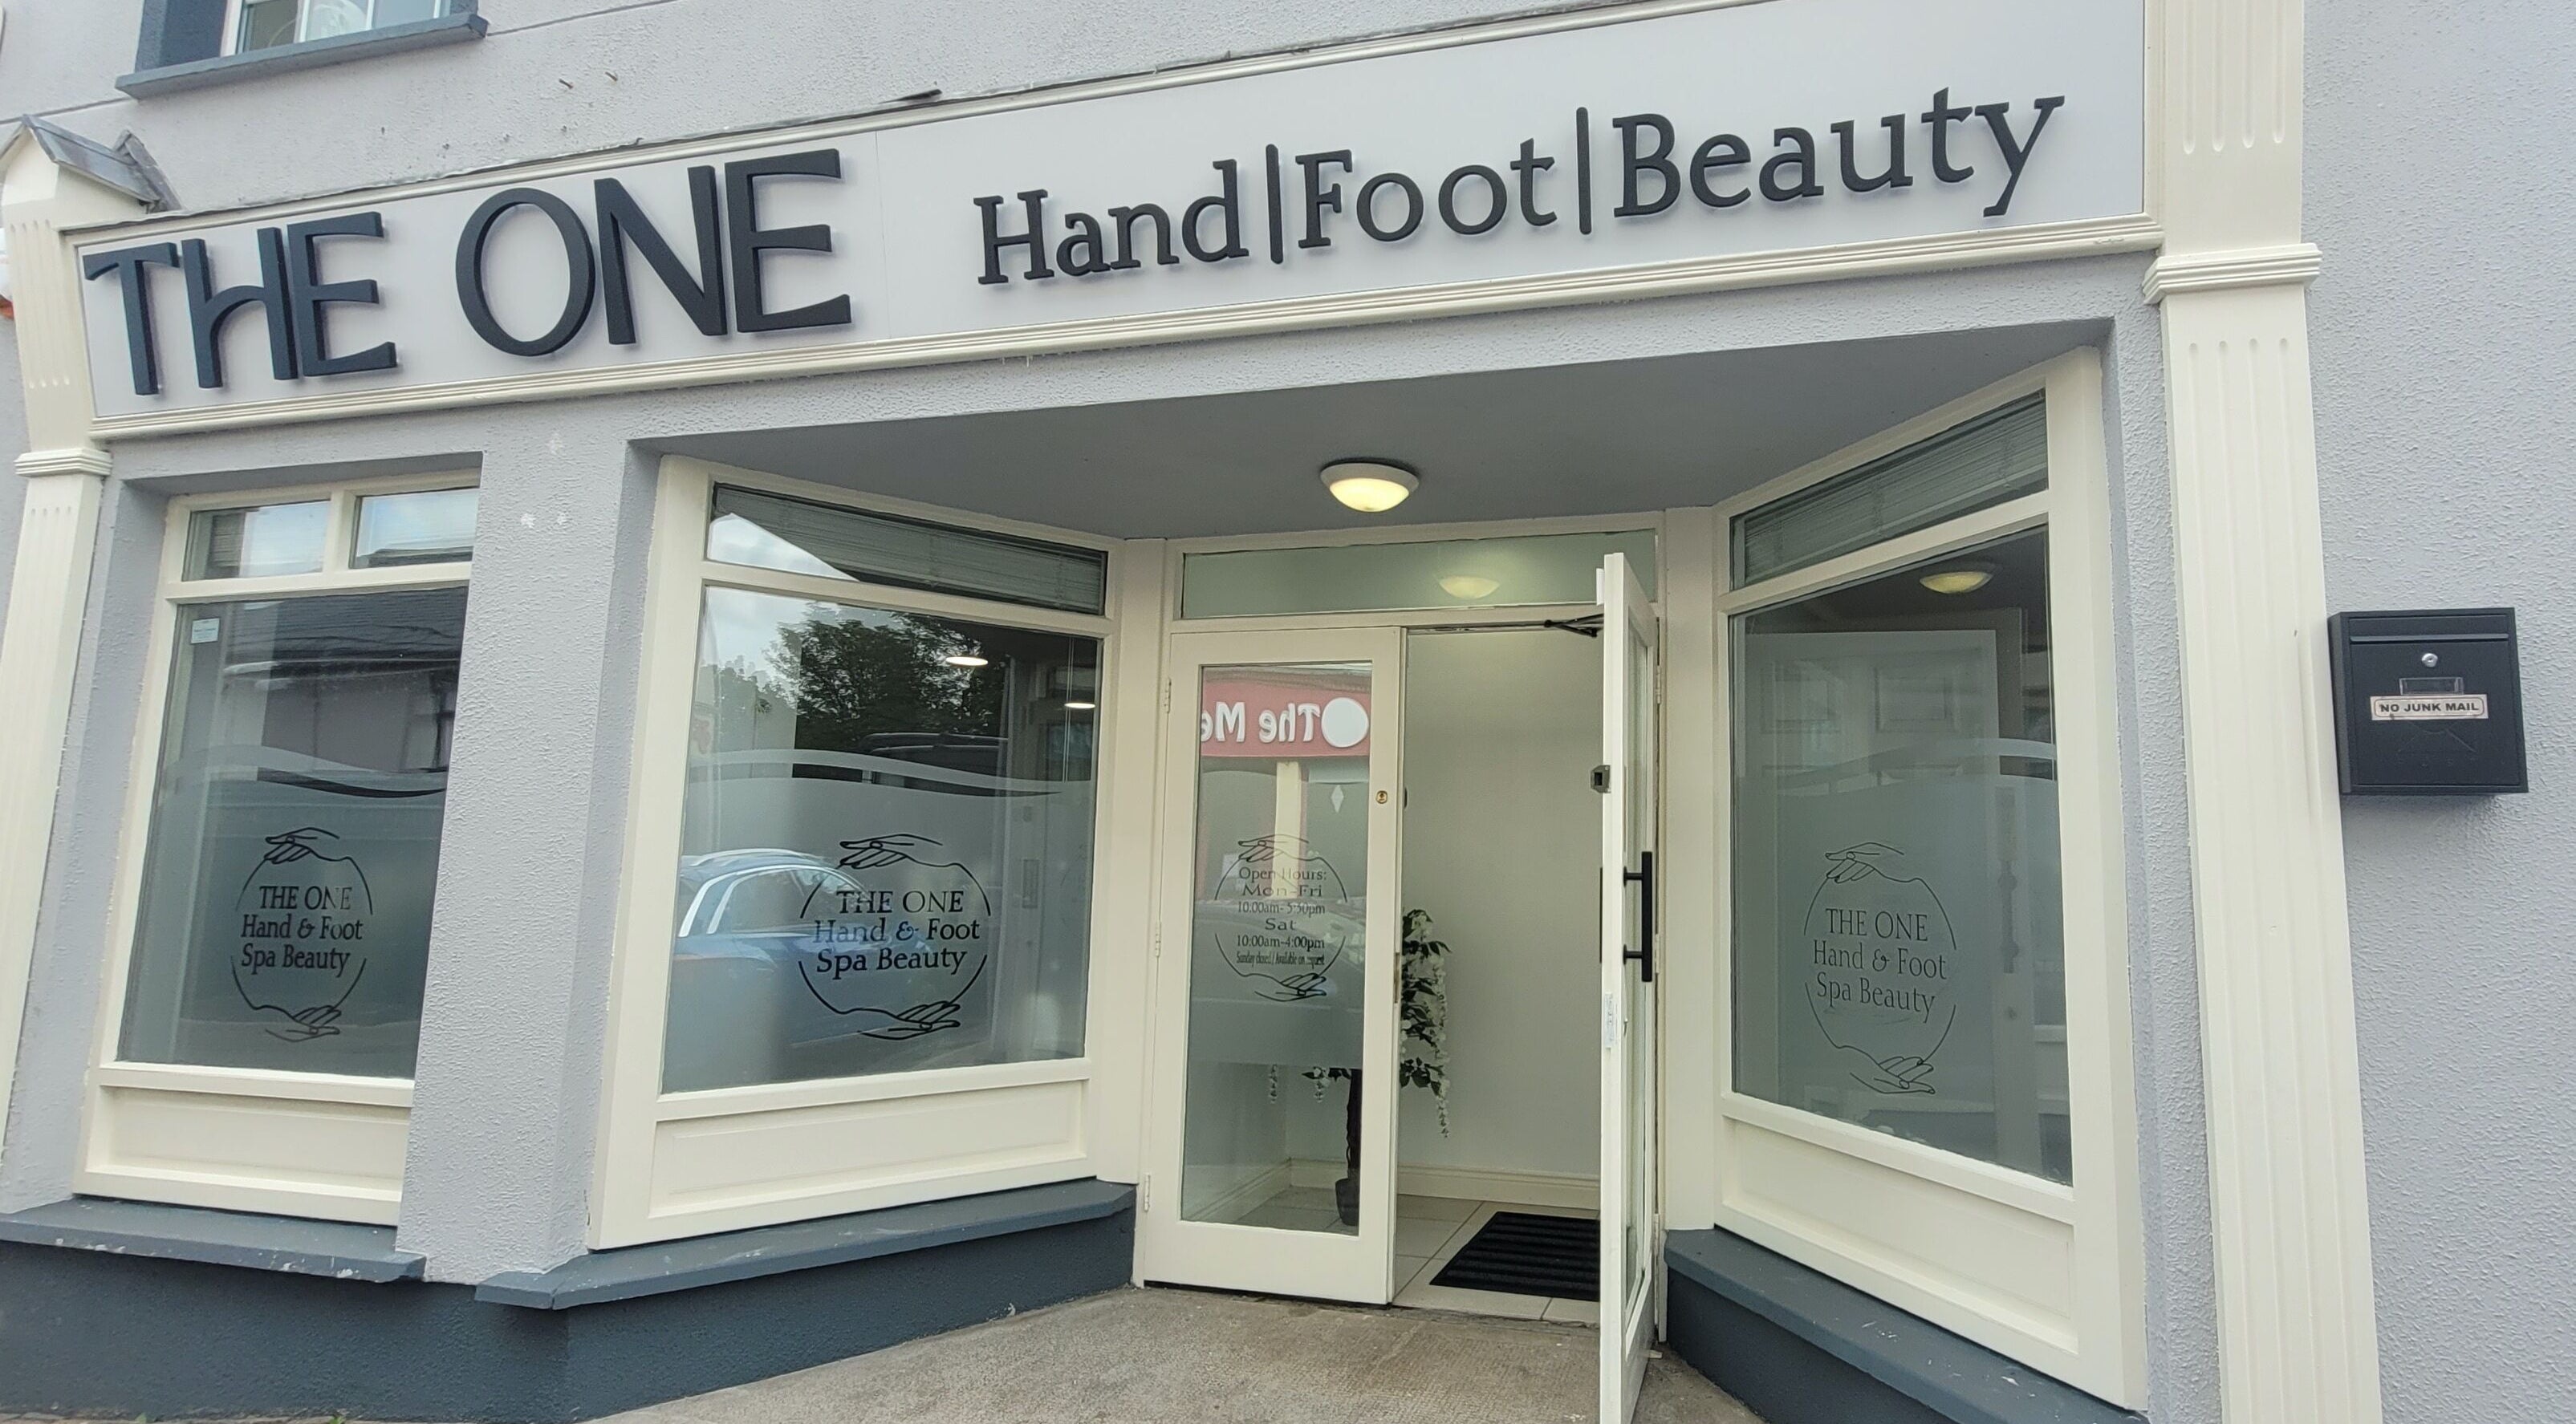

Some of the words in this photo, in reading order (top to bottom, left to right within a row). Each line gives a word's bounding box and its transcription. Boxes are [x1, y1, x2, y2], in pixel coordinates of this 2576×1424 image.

[973, 158, 1249, 285] Hand
[1295, 138, 1557, 249] Foot
[1612, 87, 2065, 218] Beauty
[84, 211, 398, 396] THE
[455, 148, 851, 358] ONE
[2379, 704, 2399, 712] NO
[2404, 703, 2441, 712] JUNK
[2445, 702, 2479, 711] MAIL
[1239, 866, 1276, 883] Open
[259, 886, 299, 910] THE
[304, 885, 353, 911] ONE
[836, 891, 893, 914] THE
[902, 891, 965, 913] ONE
[241, 913, 292, 939] Hand
[297, 918, 315, 939] &
[319, 915, 364, 939] Foot
[812, 917, 887, 943] Hand
[896, 921, 920, 941] &
[925, 918, 981, 940] Foot
[1264, 917, 1298, 931] Sat
[1826, 907, 1868, 936] THE
[1875, 911, 1928, 942] ONE
[242, 943, 276, 975] Spa
[282, 943, 351, 978] Beauty
[816, 948, 867, 980] Spa
[876, 947, 968, 976] Beauty
[1814, 939, 1865, 970] Hand
[1872, 948, 1890, 972] &
[1897, 947, 1947, 980] Foot
[1817, 972, 1852, 1008] Spa
[1859, 977, 1936, 1024] Beauty
